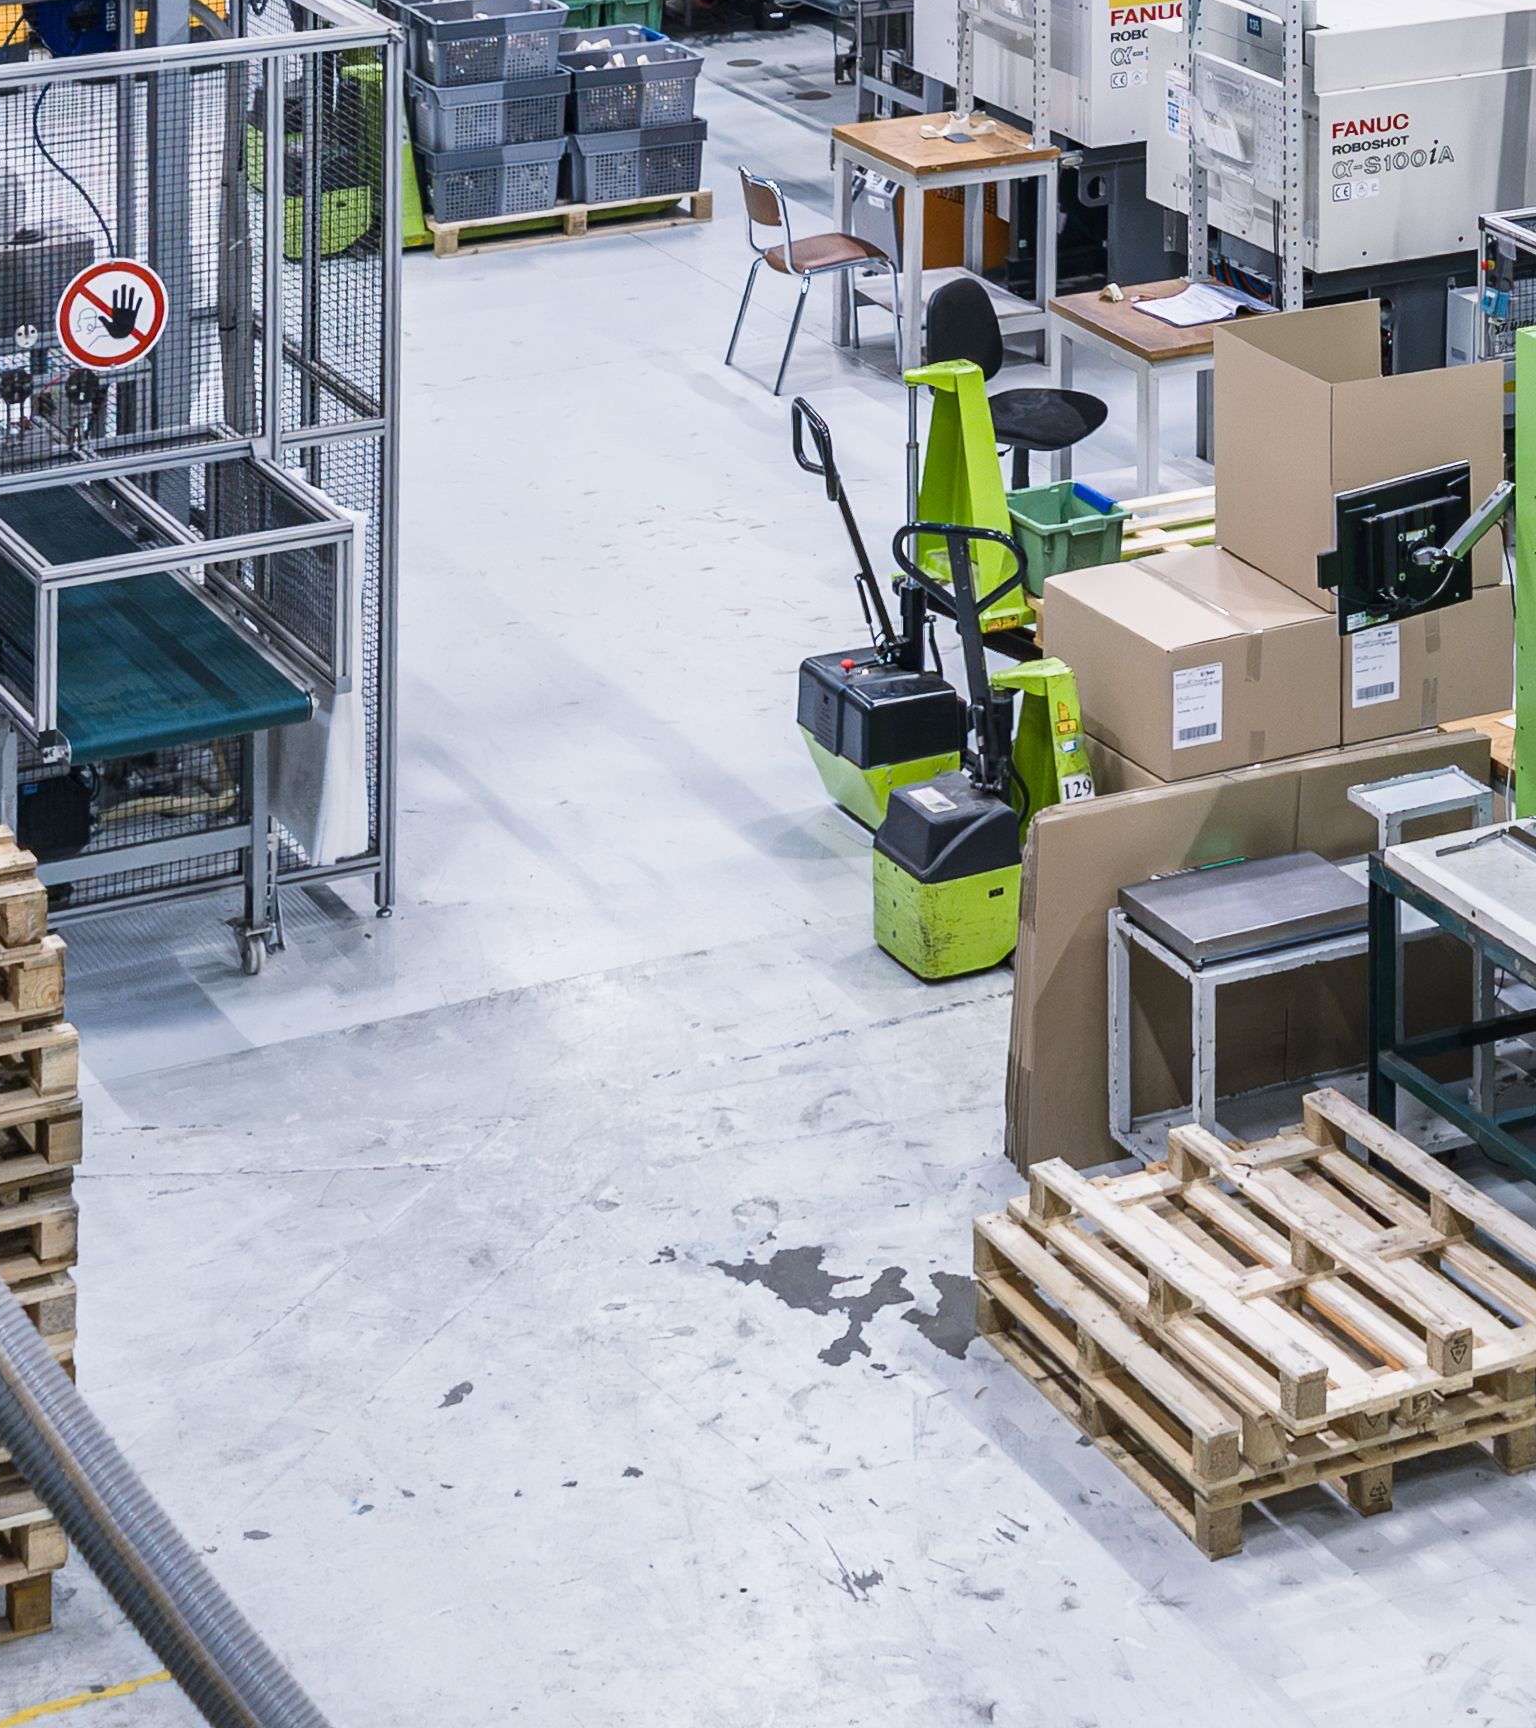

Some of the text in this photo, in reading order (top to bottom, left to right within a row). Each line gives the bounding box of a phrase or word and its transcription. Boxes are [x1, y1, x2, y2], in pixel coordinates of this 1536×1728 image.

[1332, 113, 1409, 139] FANUC
[1332, 135, 1410, 156] ROBOSHOT
[1064, 777, 1092, 800] 129
